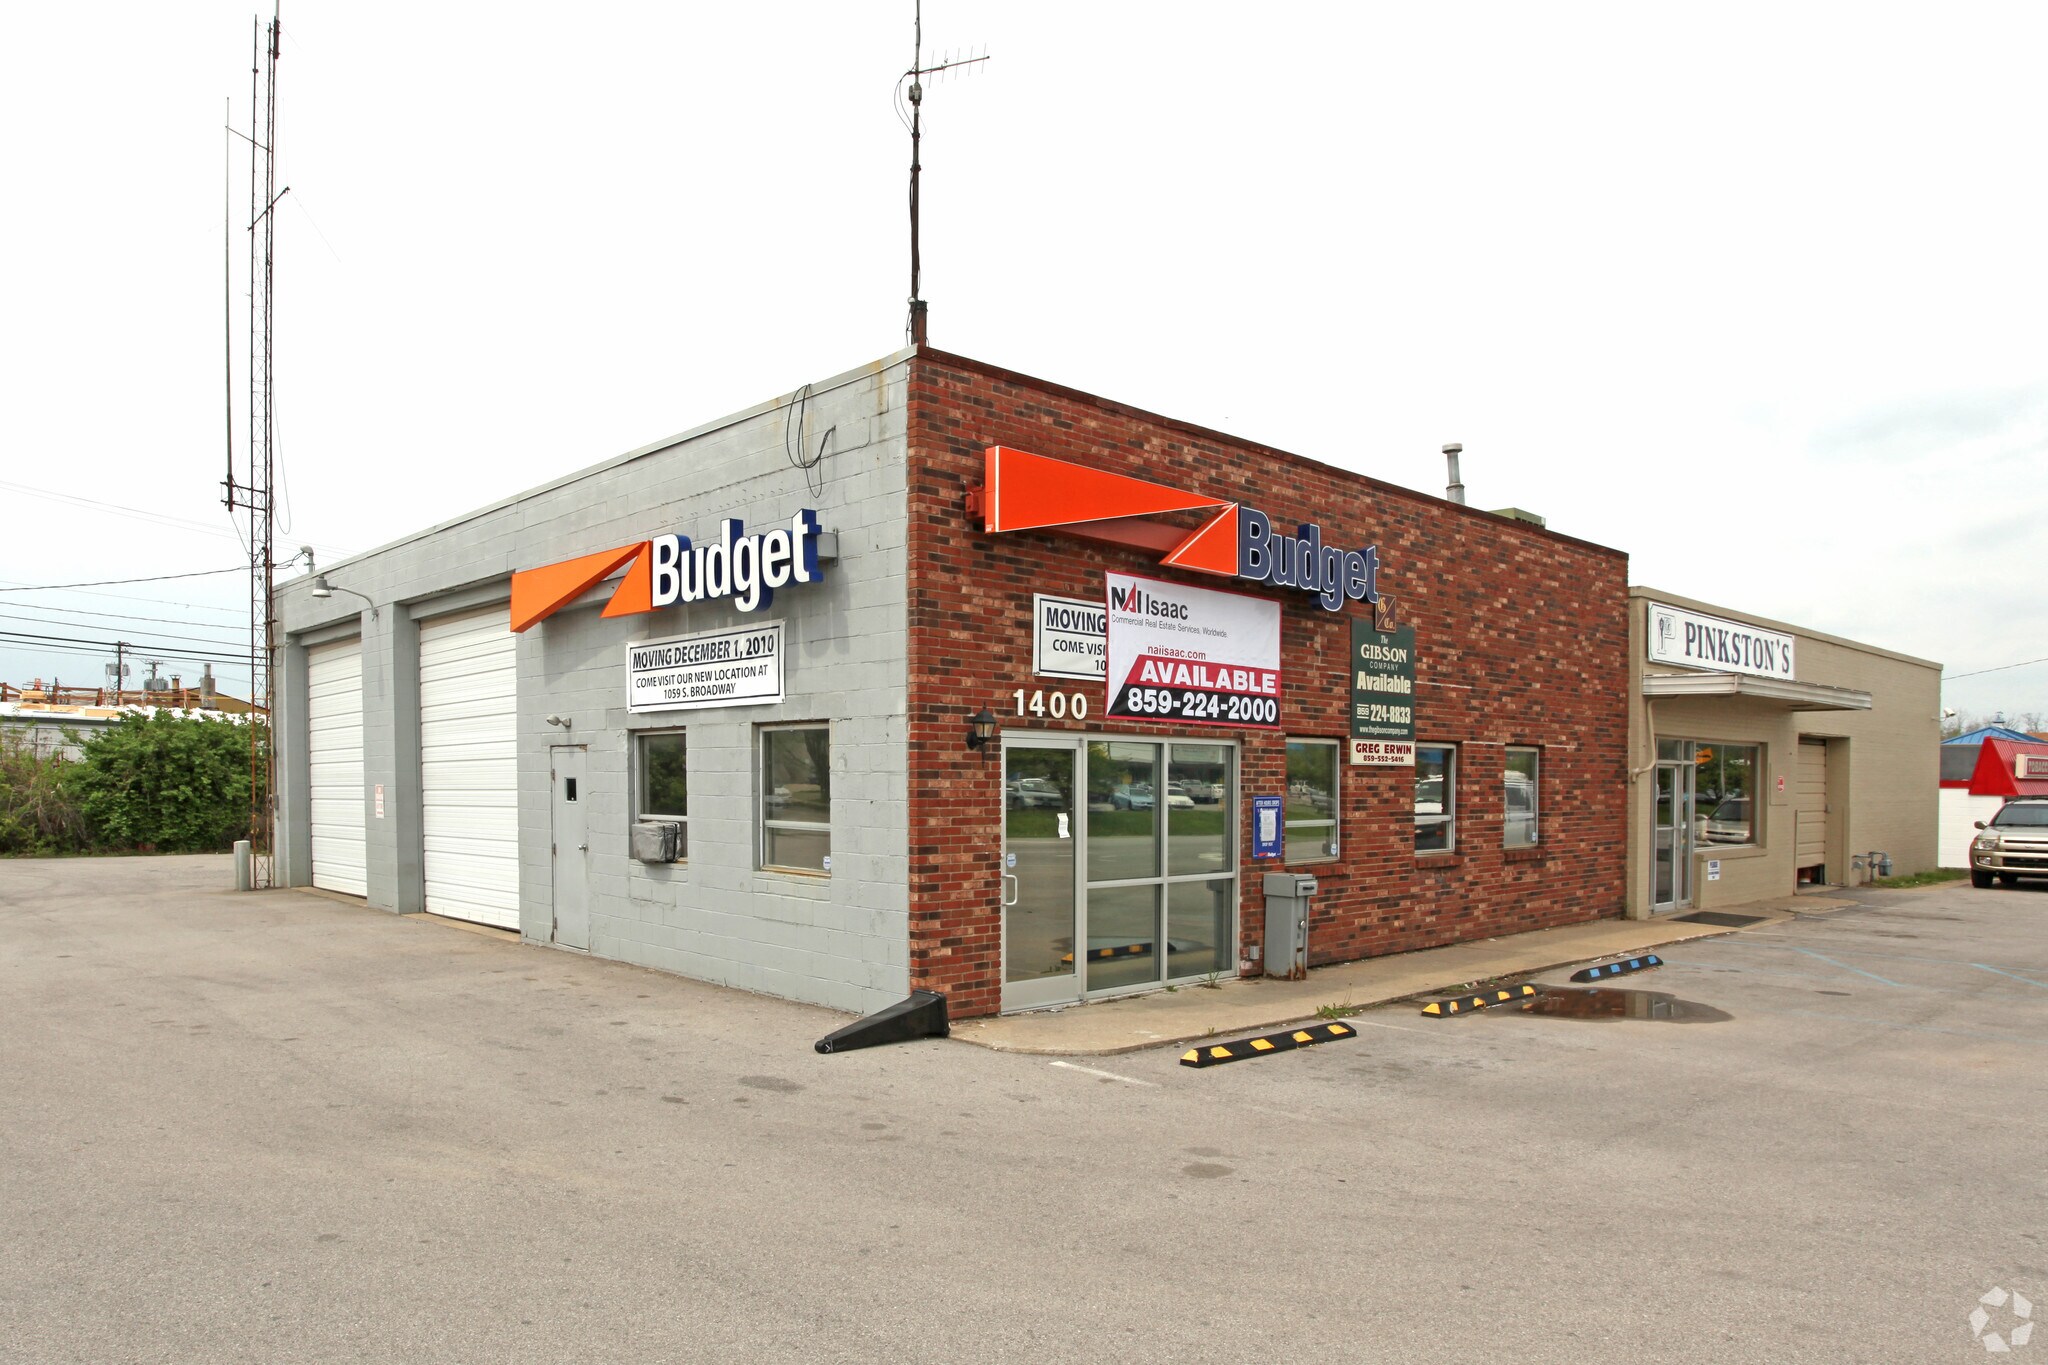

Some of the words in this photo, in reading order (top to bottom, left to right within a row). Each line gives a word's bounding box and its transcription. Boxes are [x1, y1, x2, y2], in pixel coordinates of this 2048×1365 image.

[652, 508, 822, 613] Budget
[1239, 506, 1380, 612] Budget
[1111, 582, 1142, 615] NAI
[1146, 593, 1189, 621] Isaac
[1046, 607, 1106, 634] MOVING
[1111, 614, 1144, 627] Commercial
[1145, 618, 1158, 629] Real
[1159, 621, 1176, 631] Estate
[633, 647, 673, 669] MOVING
[675, 640, 731, 665] DECEMBER
[733, 639, 744, 659] 1,
[745, 634, 774, 656] 2010
[1052, 639, 1084, 654] COME
[1380, 635, 1388, 645] The
[1684, 621, 1790, 674] PINKSTON'S
[1147, 644, 1206, 661] naiisaac.com
[1360, 643, 1407, 664] GIBSON
[636, 676, 657, 689] COME
[658, 673, 675, 687] VISIT
[676, 672, 693, 685] OUR
[694, 670, 712, 682] NEW
[714, 665, 756, 681] LOCATION
[758, 664, 768, 677] AT
[1139, 660, 1277, 695] AVAILABLE
[1369, 661, 1399, 671] COMPANY
[663, 687, 681, 699] 1059
[682, 686, 690, 697] S.
[690, 682, 737, 697] BROADWAY
[1356, 671, 1411, 695] Available
[1012, 688, 1088, 720] 1400
[1127, 687, 1278, 723] 859-224-2000
[1356, 706, 1369, 716] 859
[1370, 704, 1411, 724] 224-8833
[1355, 742, 1380, 754] GREG
[1384, 743, 1412, 755] ERWIN
[1363, 754, 1404, 763] 859-552-5416
